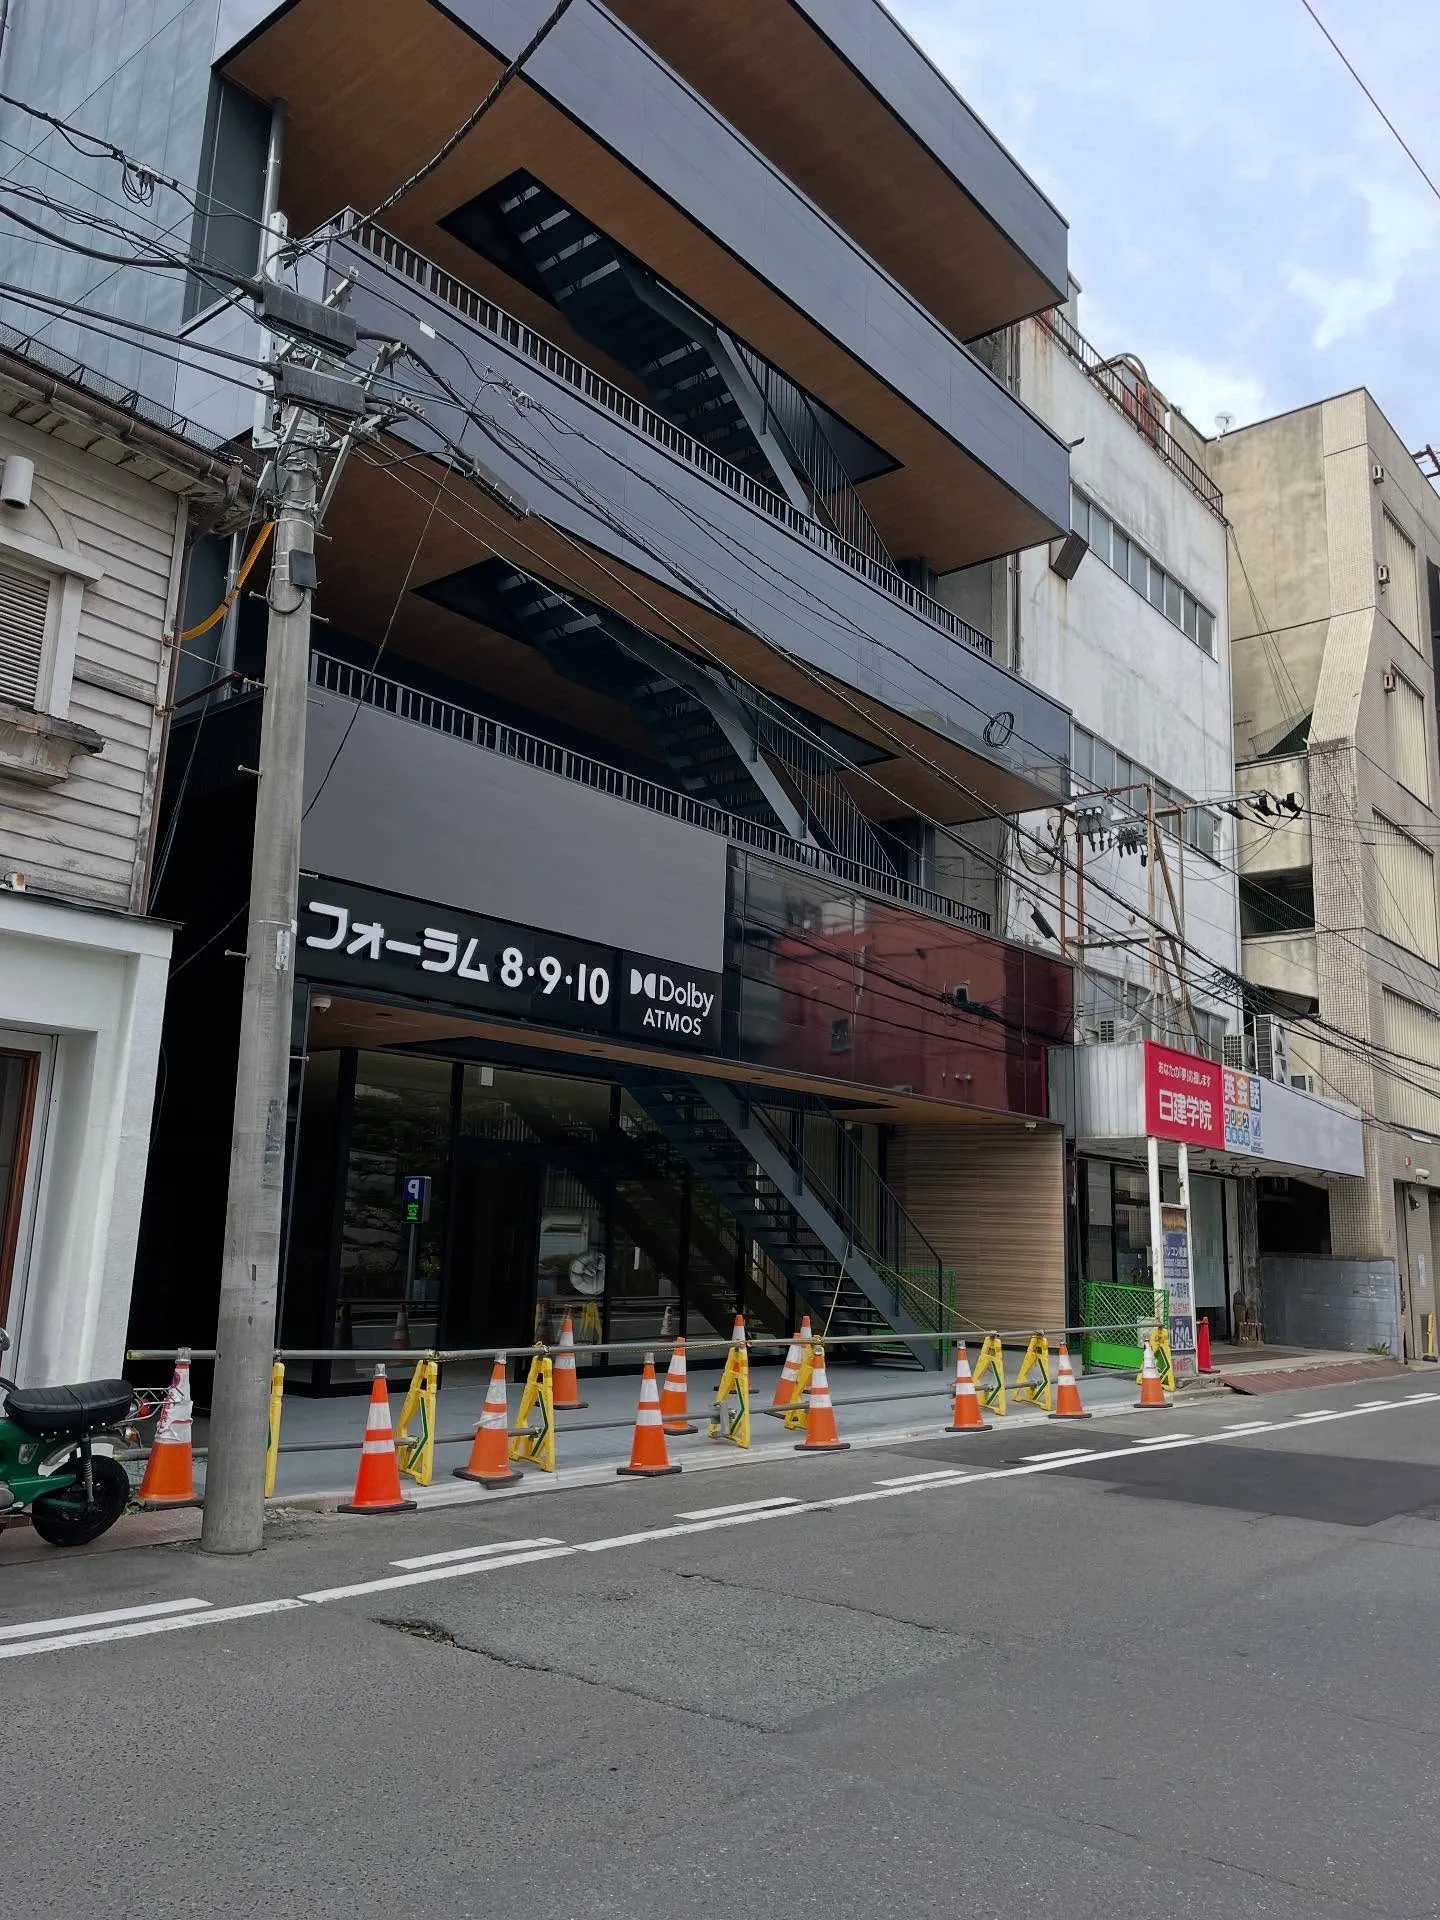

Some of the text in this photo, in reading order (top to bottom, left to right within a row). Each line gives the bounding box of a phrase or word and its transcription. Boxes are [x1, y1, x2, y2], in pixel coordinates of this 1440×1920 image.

[306, 901, 489, 983] フォーラム
[659, 974, 715, 1017] Dolby
[642, 1007, 702, 1036] ATMOS
[1159, 1089, 1213, 1131] 日建学院
[1223, 1072, 1261, 1111] 英会話
